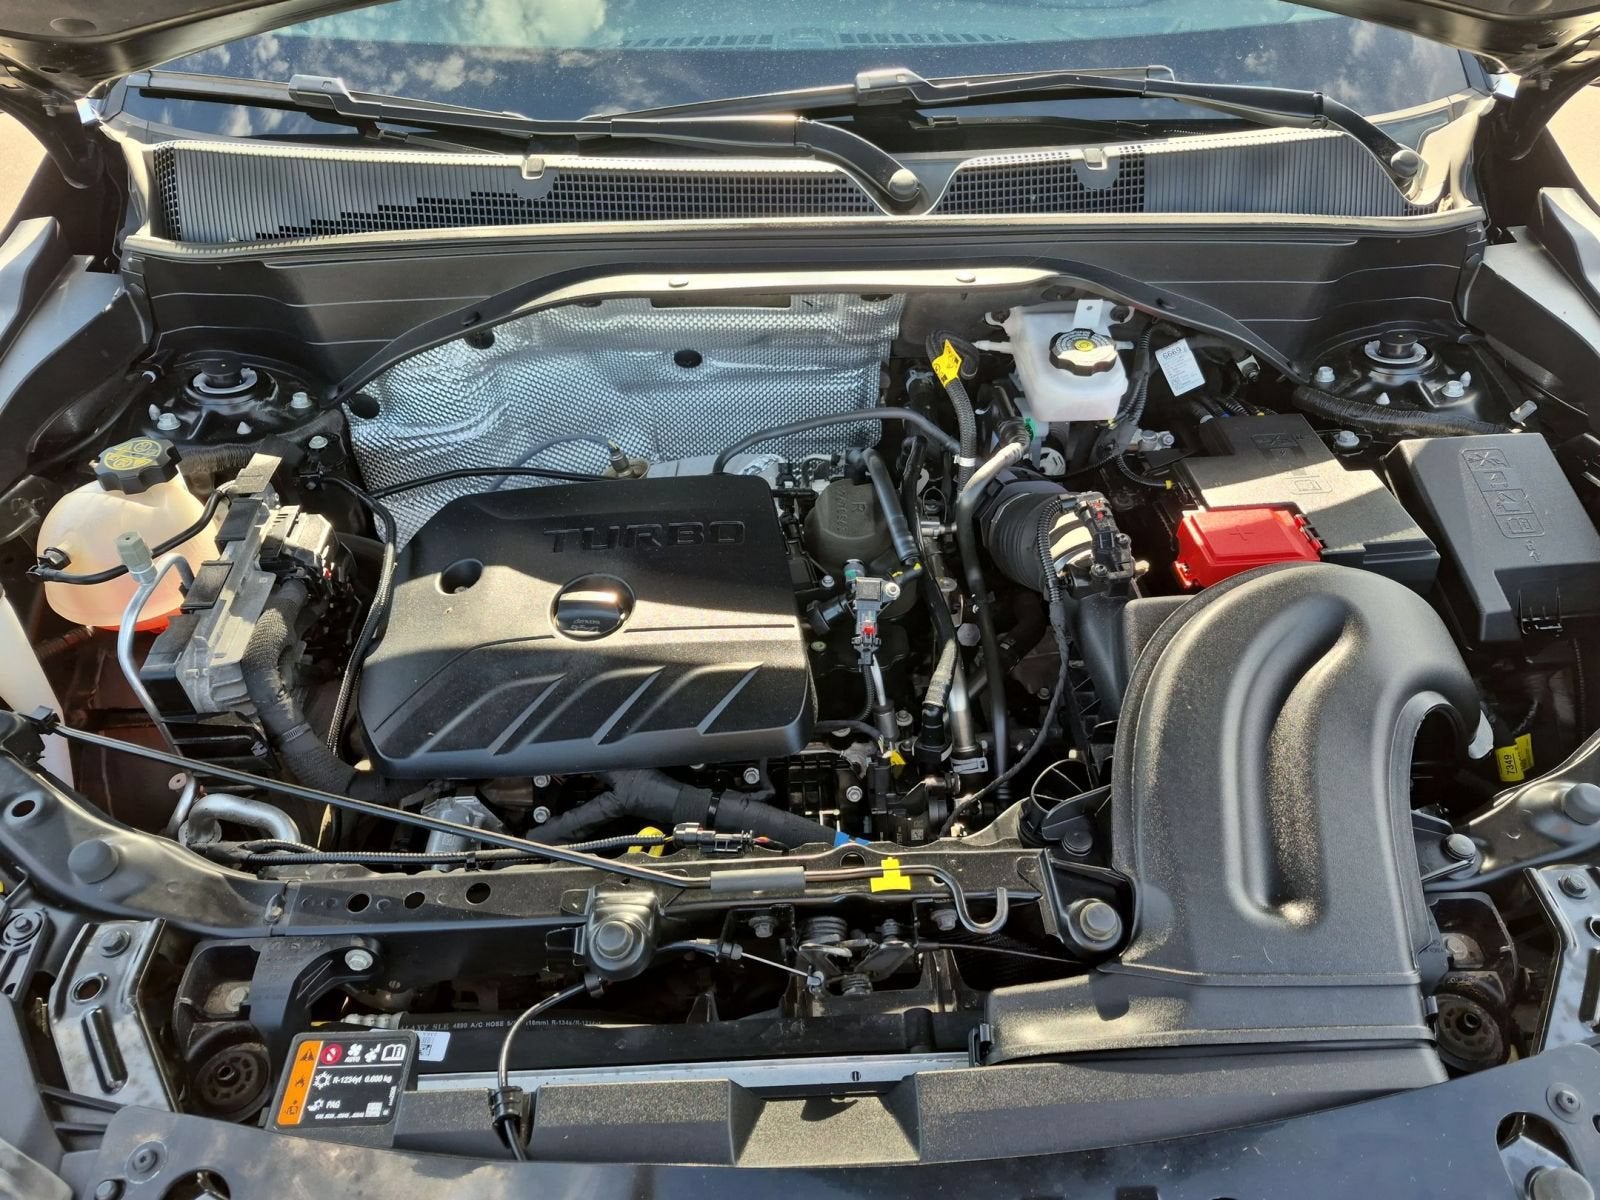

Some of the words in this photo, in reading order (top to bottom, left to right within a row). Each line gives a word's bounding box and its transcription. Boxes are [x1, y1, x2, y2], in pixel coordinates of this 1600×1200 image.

[544, 520, 745, 552] TURBO
[1503, 754, 1516, 775] 7349
[326, 1100, 341, 1109] PAG
